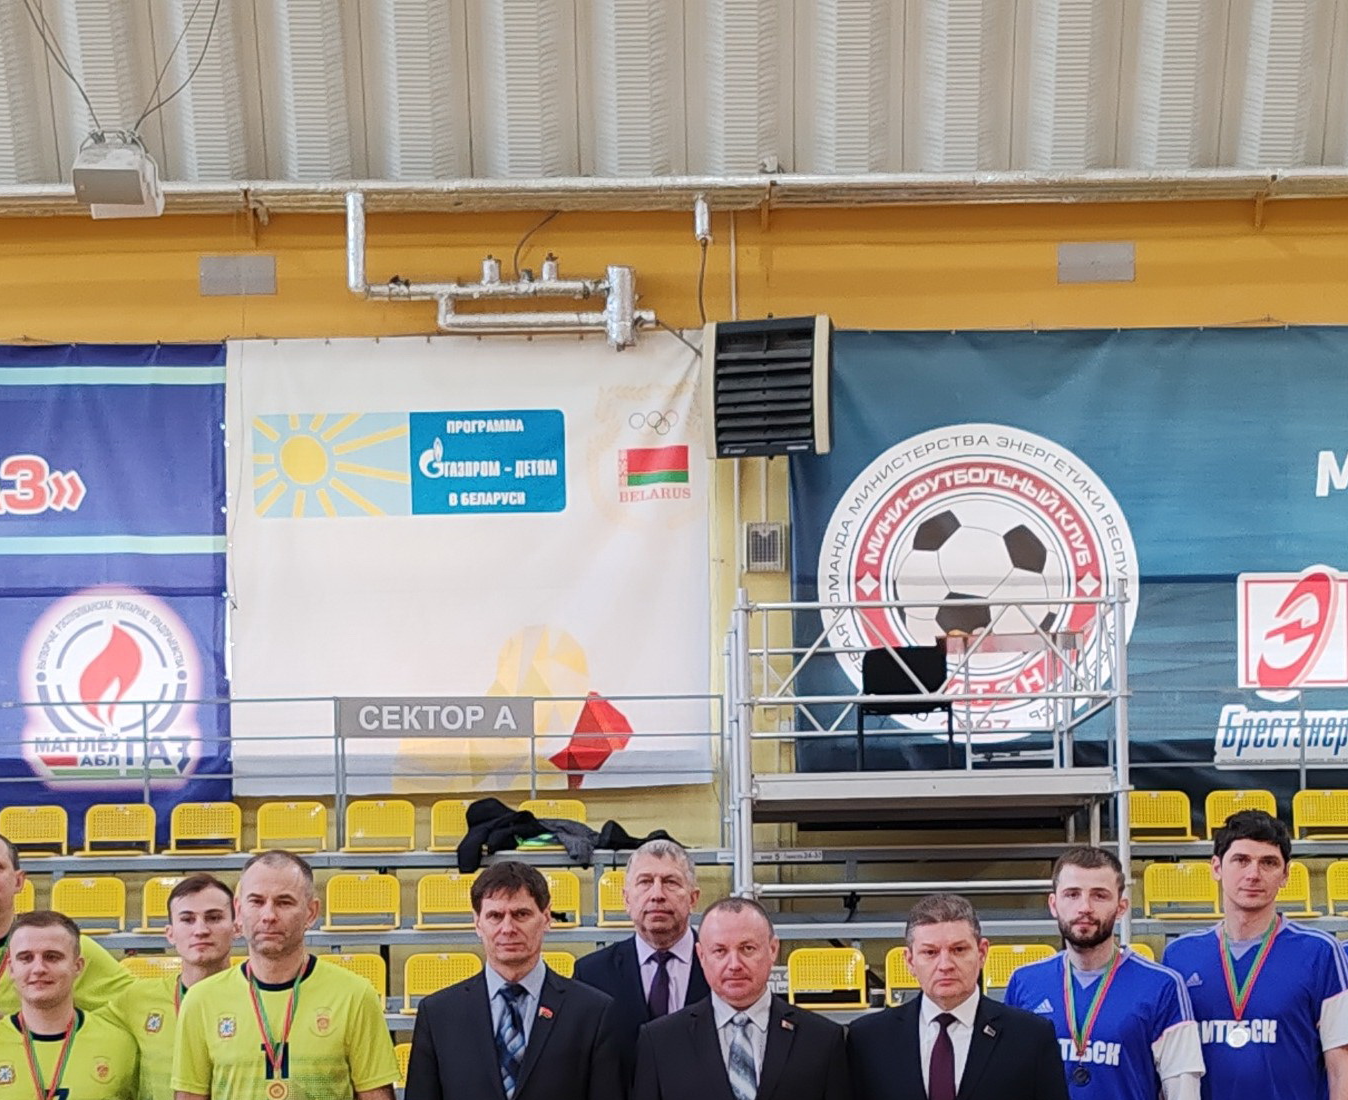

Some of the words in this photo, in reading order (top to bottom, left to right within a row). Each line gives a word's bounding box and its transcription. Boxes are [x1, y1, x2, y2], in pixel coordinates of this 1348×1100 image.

[446, 419, 524, 434] ПРОГРАММА
[515, 460, 558, 478] ДЕТЯМ
[851, 434, 991, 516] МИНИСТЕРСТВА
[996, 436, 1106, 513] ЭНЕРГЕТИКИ
[461, 492, 526, 505] БЕЛАРУСИ
[619, 486, 691, 503] BELARUS
[865, 467, 1060, 564] МИНИ-ФУТБОЛЬНЫЙ
[1055, 506, 1092, 566] КЛУБ
[358, 705, 486, 731] СЕКТОР
[80, 756, 119, 766] АБЛ
[126, 736, 191, 774] ГАЗ
